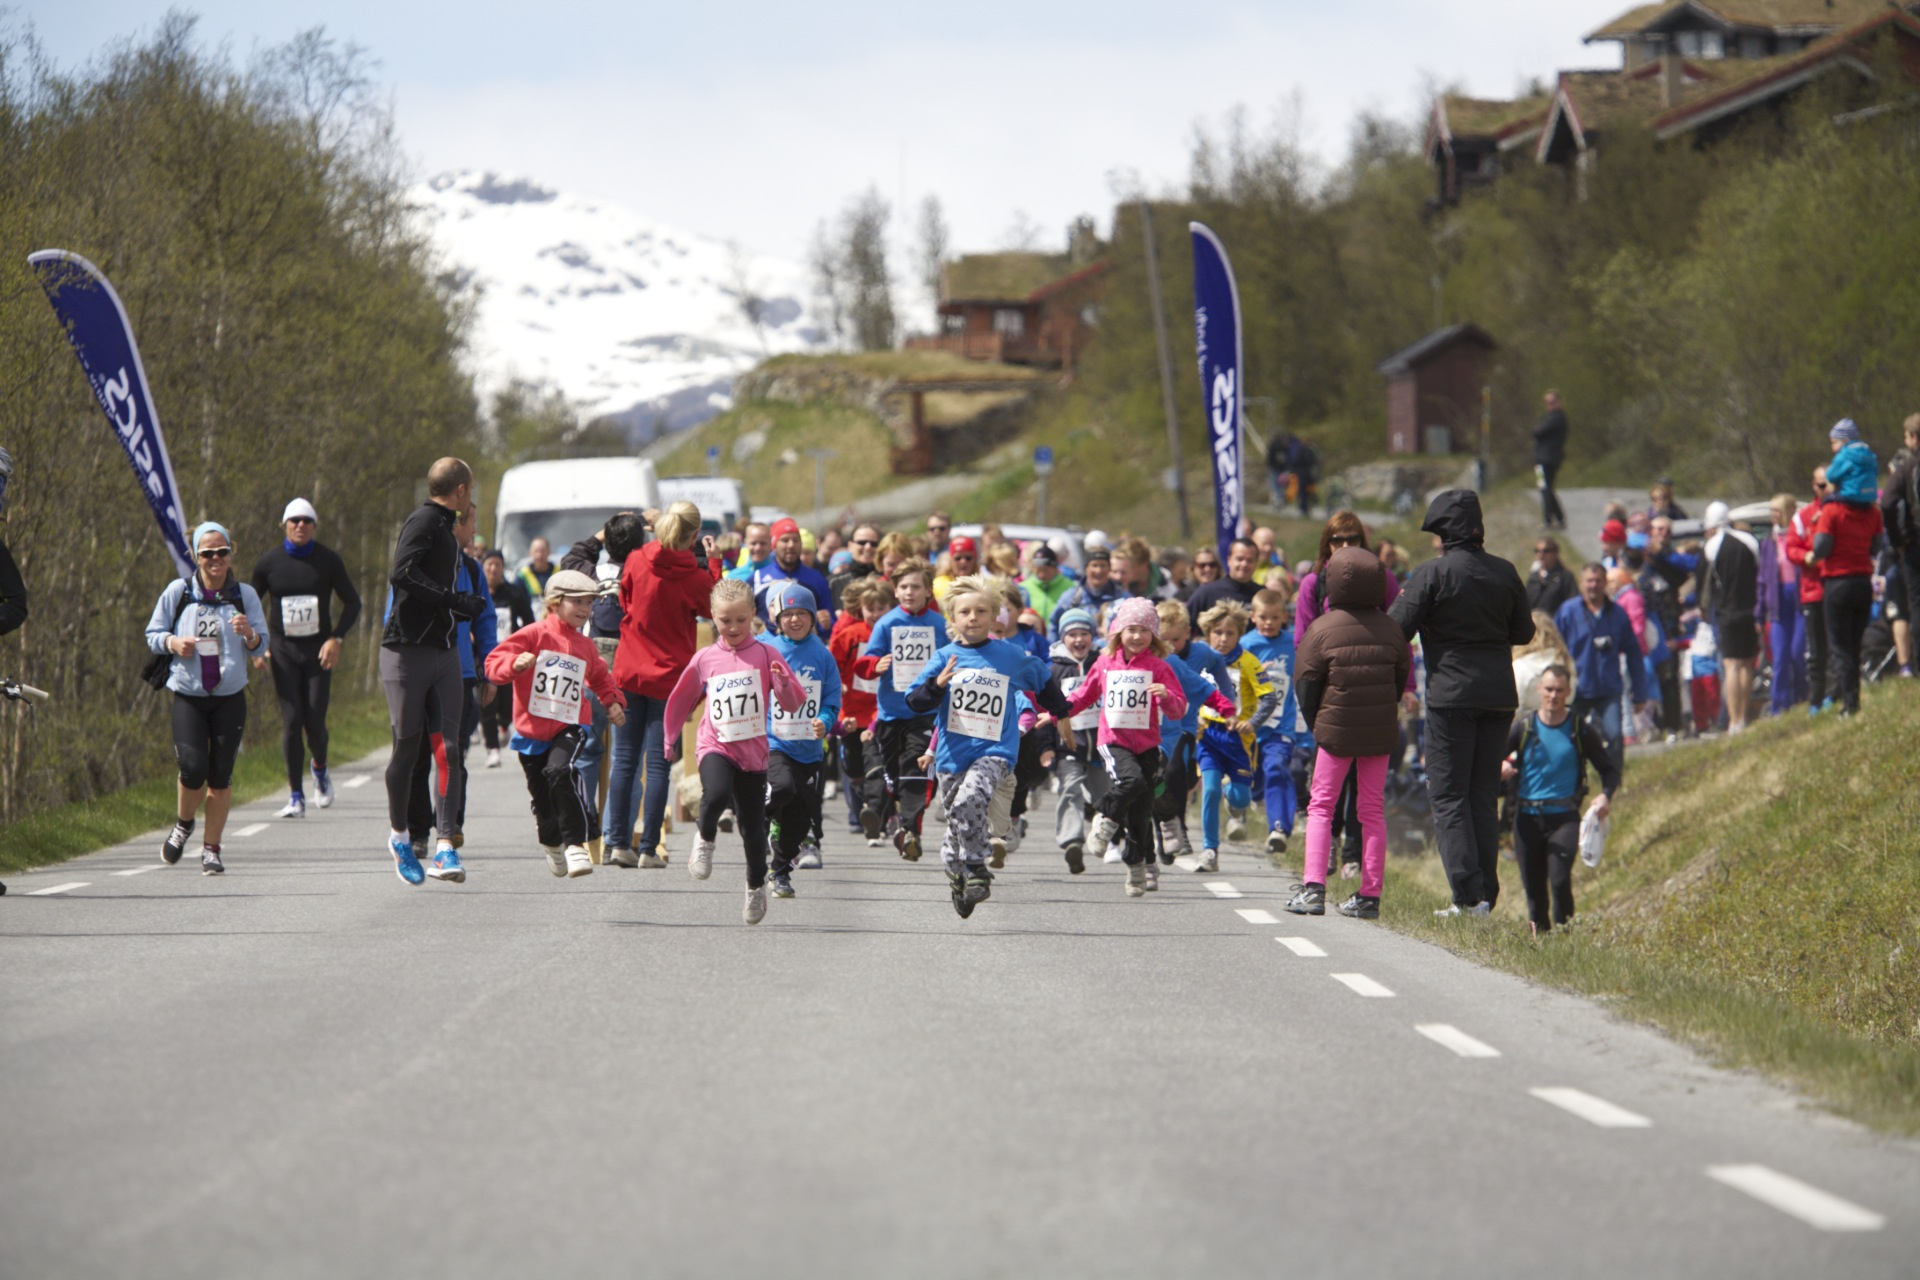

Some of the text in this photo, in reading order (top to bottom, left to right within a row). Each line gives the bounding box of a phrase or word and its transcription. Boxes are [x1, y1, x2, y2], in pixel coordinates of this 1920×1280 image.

[288, 608, 312, 622] 717
[909, 631, 929, 639] asics
[895, 643, 931, 662] 3221
[559, 659, 579, 673] asics
[727, 676, 753, 688] asics
[975, 676, 1001, 688] asics
[1123, 675, 1145, 684] asics
[535, 672, 579, 702] 3175
[952, 688, 1003, 717] 3220
[1107, 689, 1148, 708] 3184
[713, 692, 759, 720] 3171
